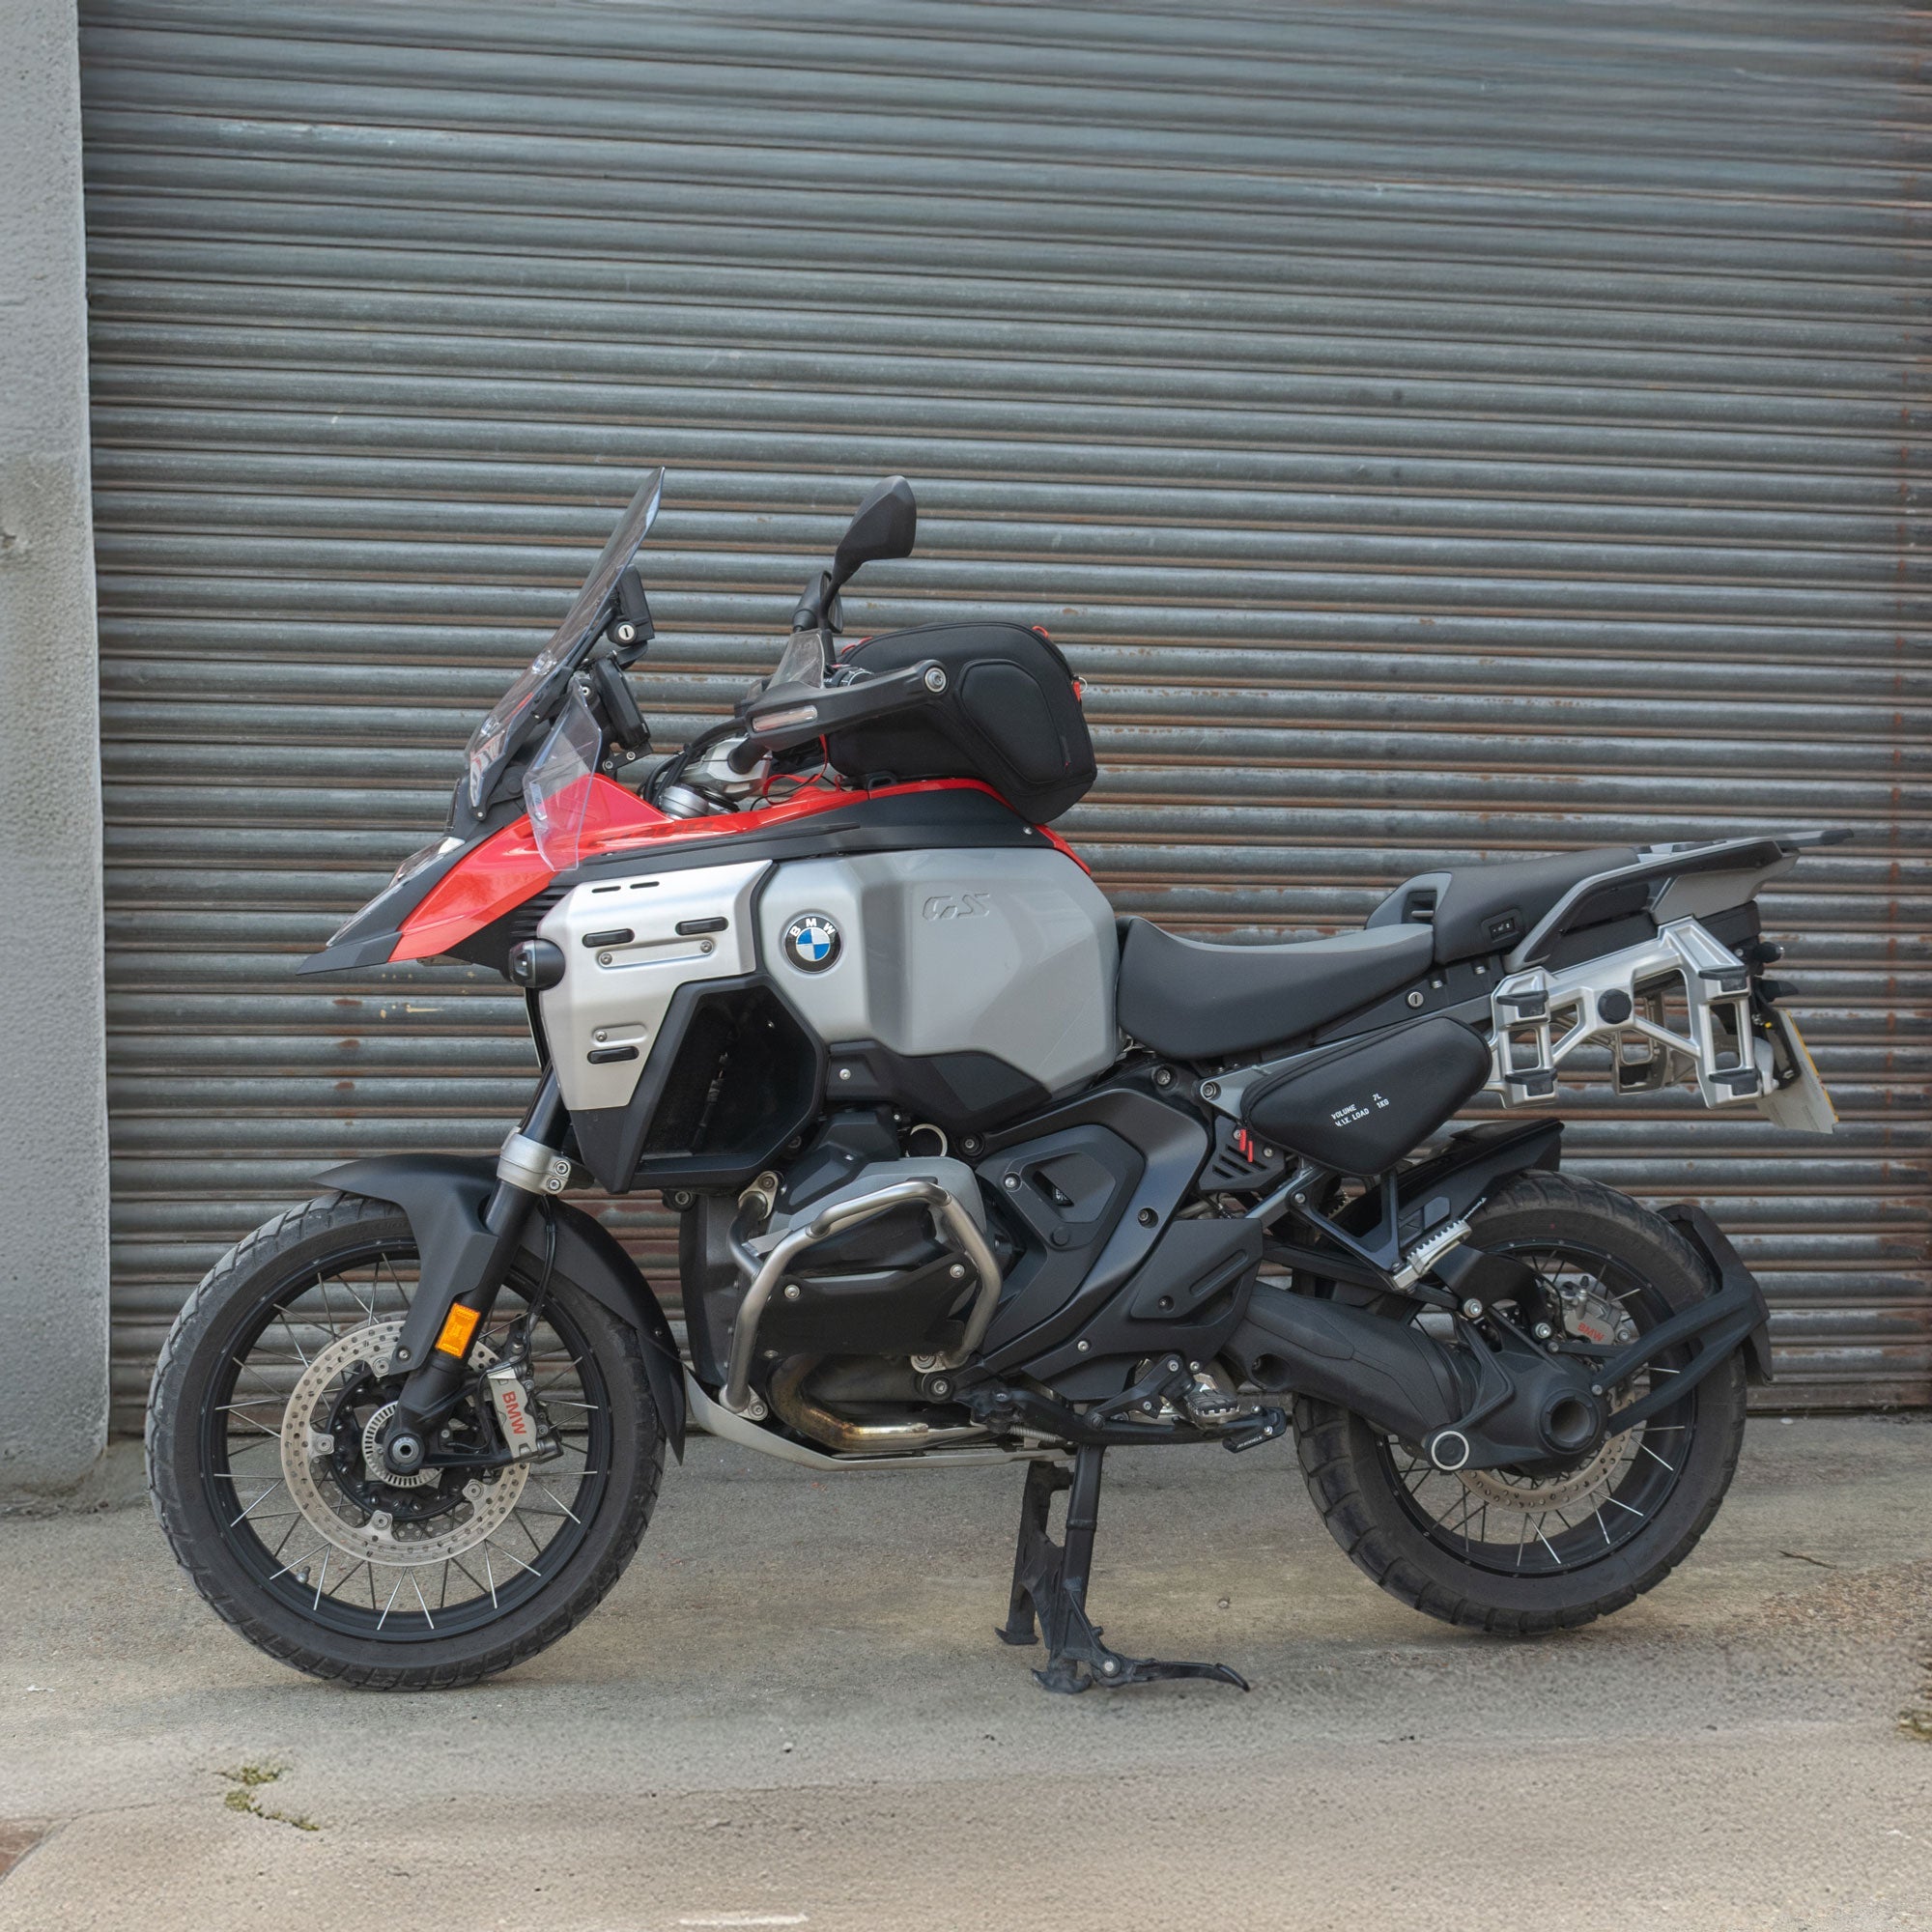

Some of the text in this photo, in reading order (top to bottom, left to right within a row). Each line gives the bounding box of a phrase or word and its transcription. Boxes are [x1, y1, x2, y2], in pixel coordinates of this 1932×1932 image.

[923, 893, 990, 921] GS
[789, 918, 837, 937] BMW
[1331, 1104, 1356, 1120] VOLUME
[1351, 1108, 1370, 1120] LOAD
[1577, 1322, 1605, 1341] BMW
[502, 1391, 527, 1435] BMW
